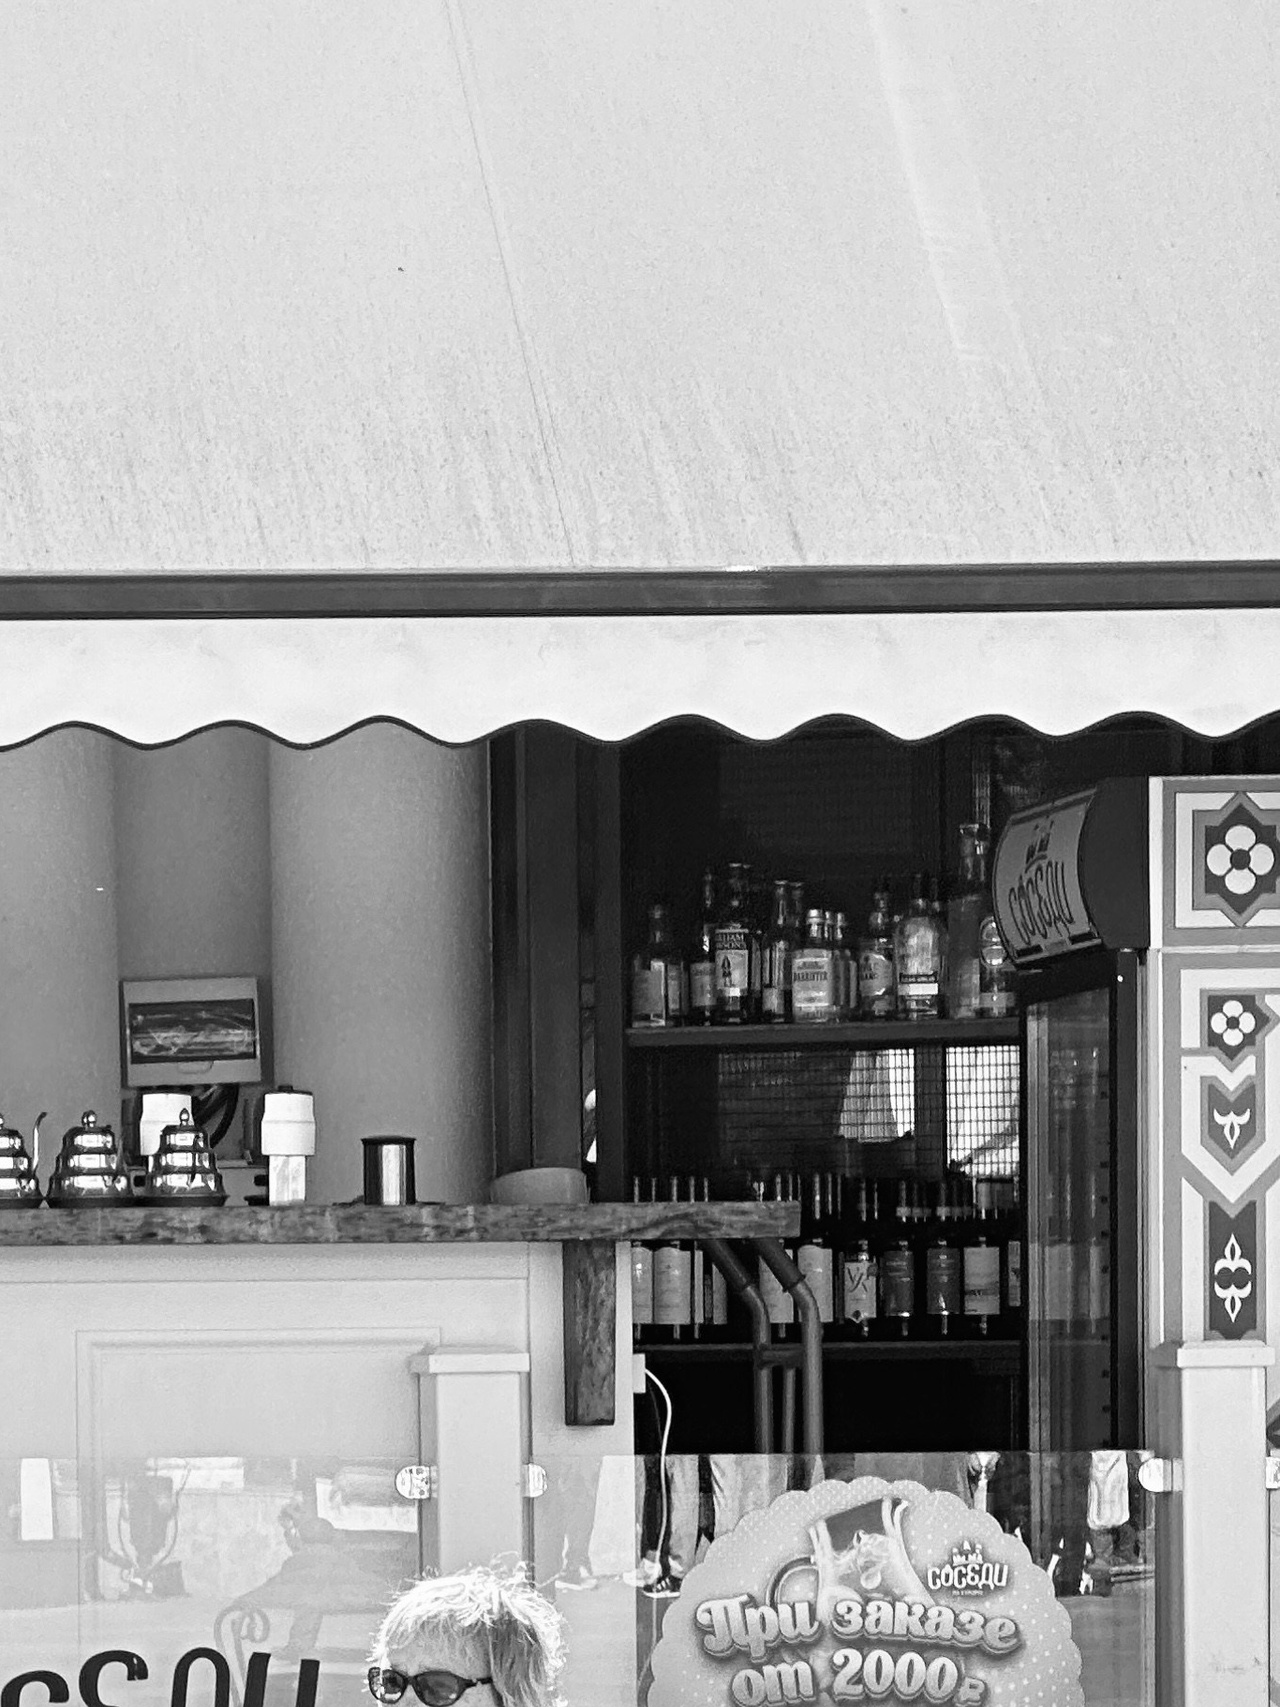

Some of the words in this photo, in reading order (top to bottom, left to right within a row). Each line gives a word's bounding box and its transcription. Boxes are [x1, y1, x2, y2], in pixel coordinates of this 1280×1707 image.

[927, 1562, 1009, 1590] СОСЕДИ
[695, 1594, 820, 1662] При
[831, 1599, 1021, 1654] заказе
